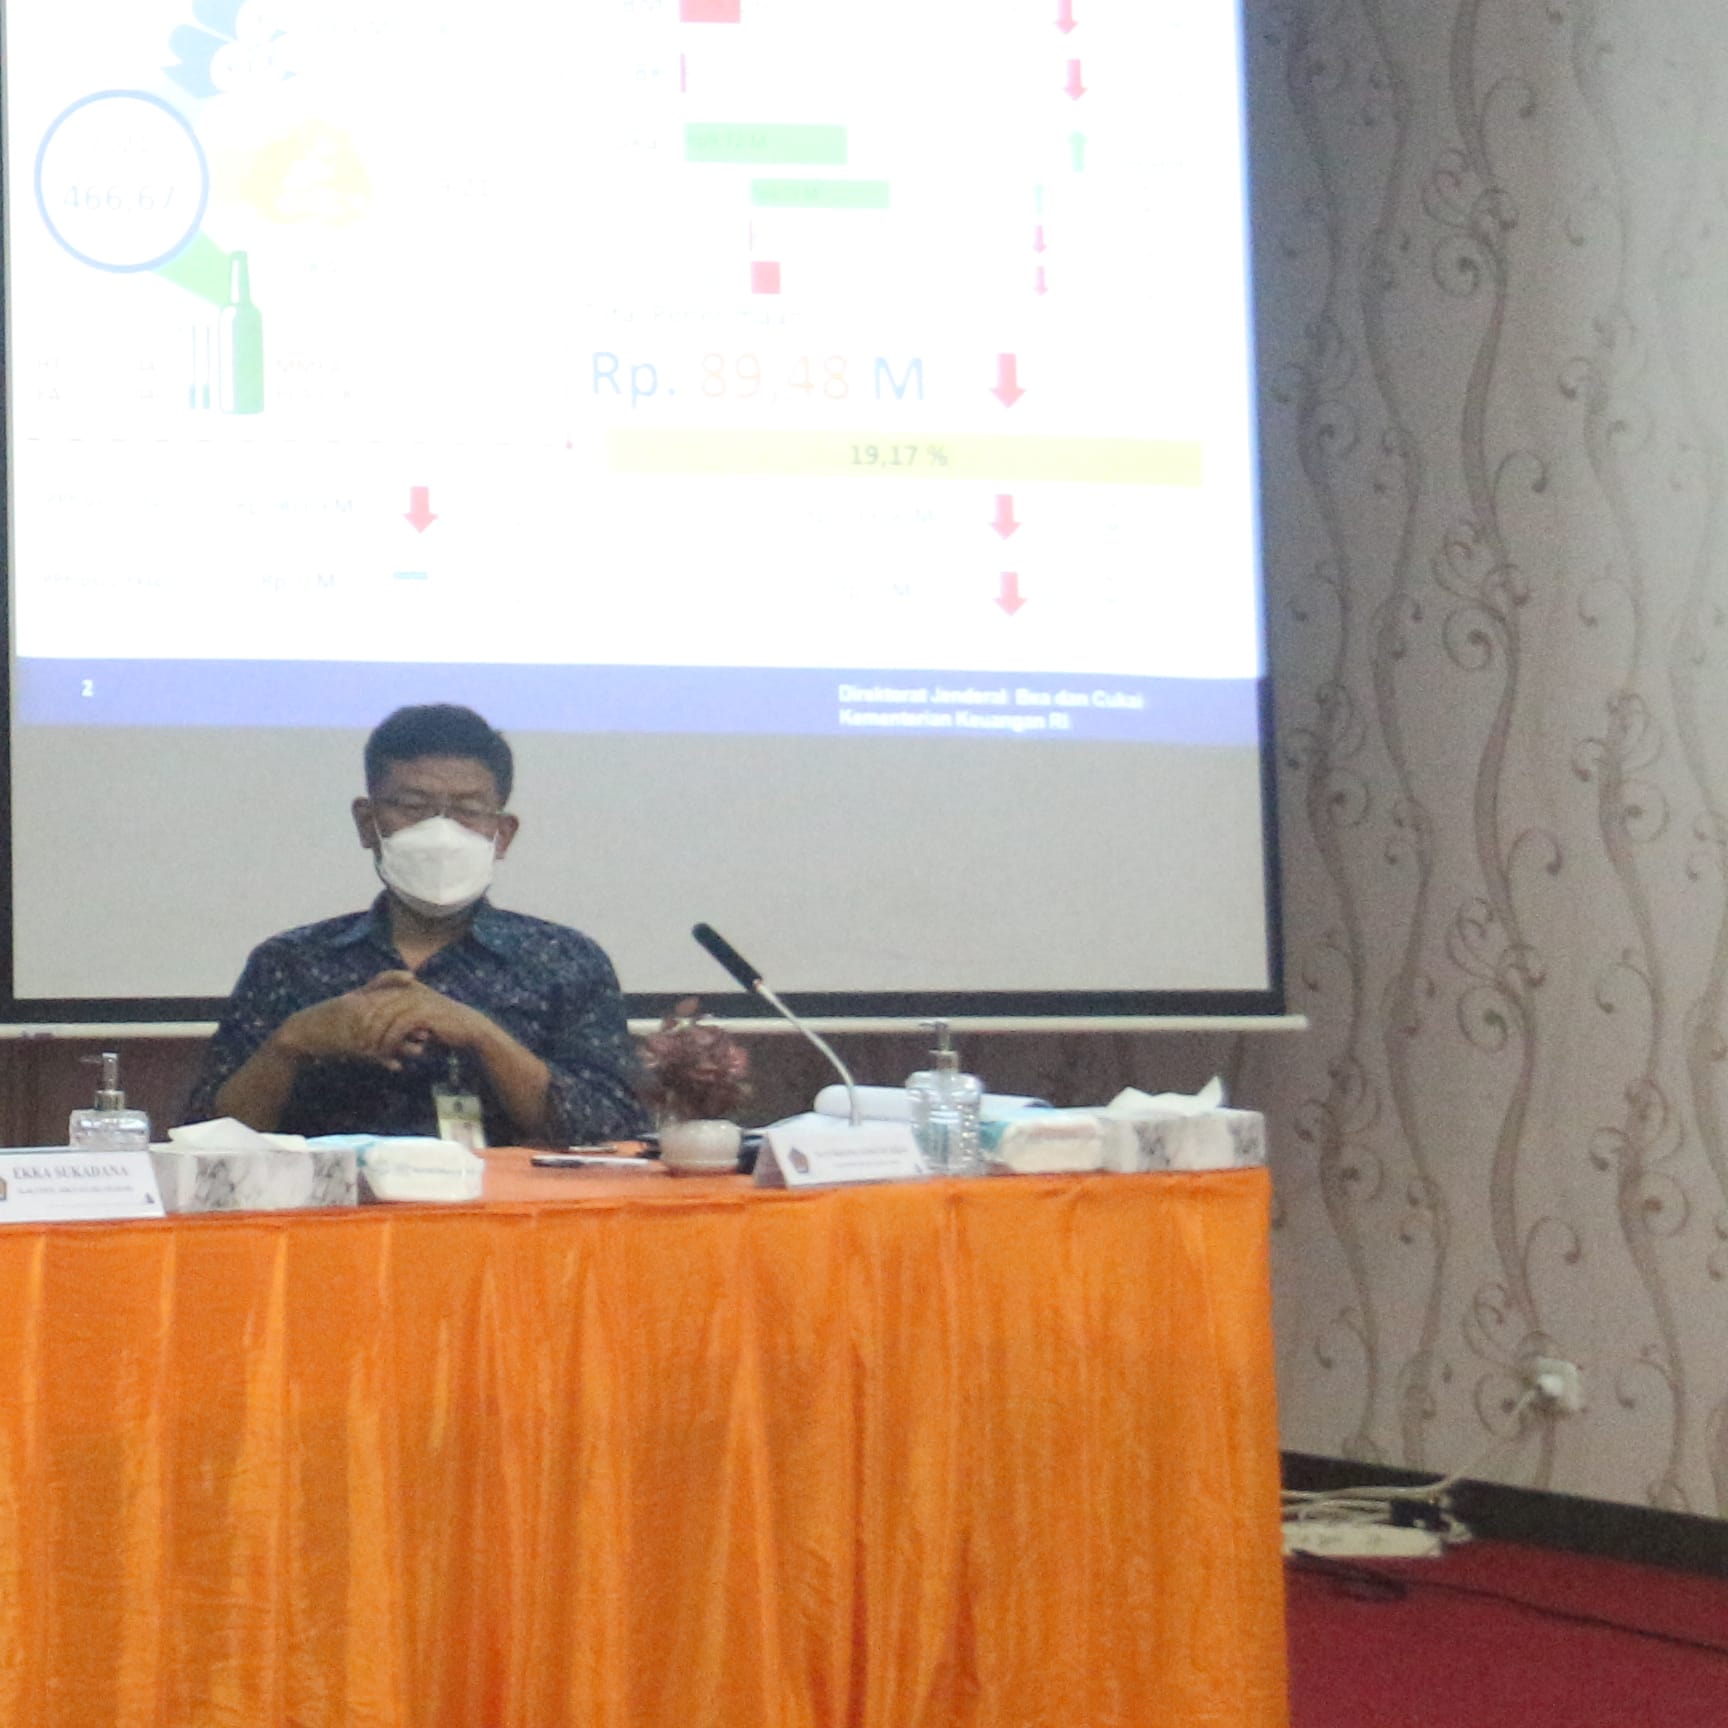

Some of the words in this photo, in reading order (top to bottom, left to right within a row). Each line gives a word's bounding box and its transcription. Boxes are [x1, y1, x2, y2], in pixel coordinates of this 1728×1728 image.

[591, 349, 677, 409] Rp.
[873, 356, 925, 401] M
[848, 443, 919, 470] 19,17
[927, 445, 949, 468] %
[80, 678, 95, 698] 2
[838, 684, 928, 704] Direktorat
[1054, 689, 1089, 707] dan
[1091, 689, 1145, 710] Cukai
[838, 708, 952, 727] Kementerian
[955, 710, 1047, 732] Keuangan
